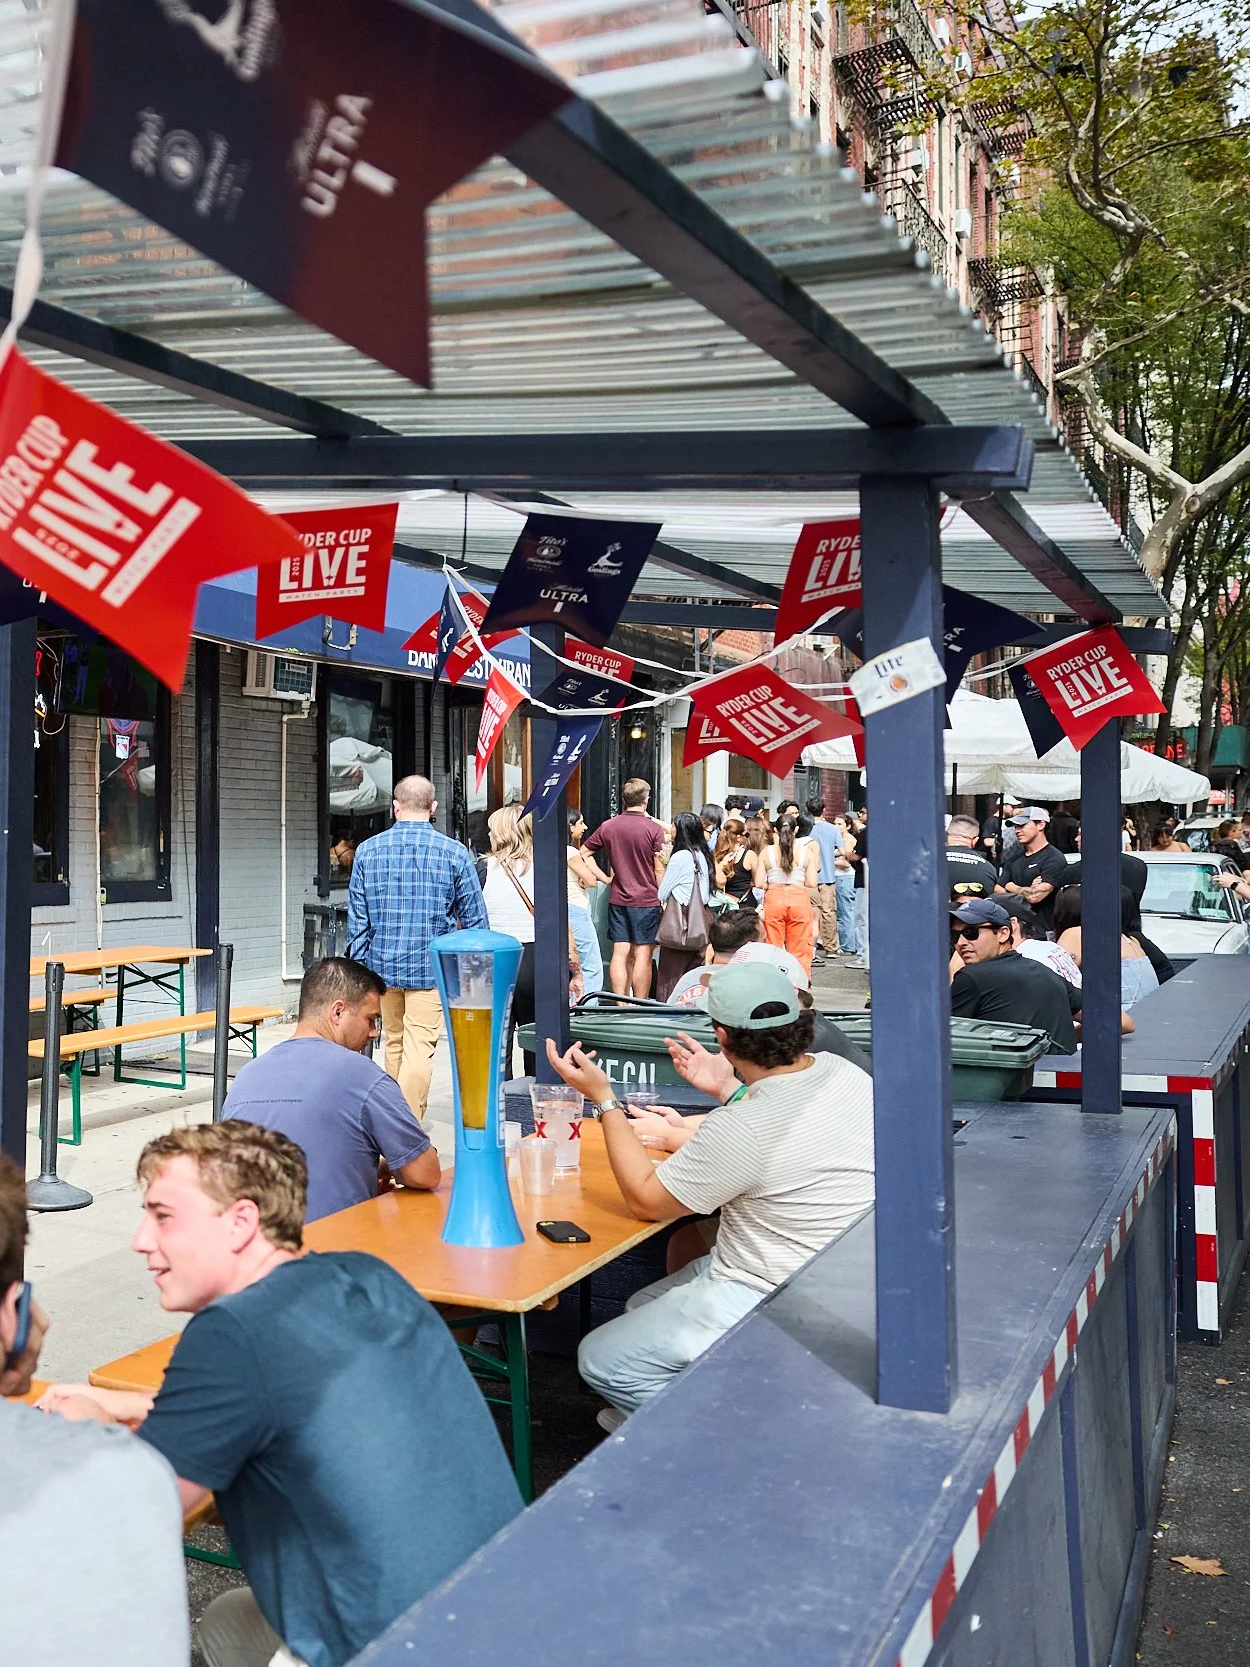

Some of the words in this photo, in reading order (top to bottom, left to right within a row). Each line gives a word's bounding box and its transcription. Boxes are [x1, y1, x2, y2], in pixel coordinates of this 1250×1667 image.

[301, 94, 374, 218] ULTRA
[15, 414, 70, 470] CUP
[10, 438, 174, 592] LIVE
[297, 531, 336, 548] DER
[339, 528, 372, 544] CUP
[816, 534, 861, 554] RYDE
[279, 545, 370, 590] LIVE
[804, 550, 861, 592] LIV
[286, 592, 320, 600] WATCH
[540, 589, 588, 603] ULTRA
[574, 651, 603, 664] RYDER
[604, 658, 622, 669] CUP
[1046, 656, 1086, 680] RYDER
[1084, 645, 1107, 662] CUP
[1054, 656, 1129, 710] LIVE
[715, 694, 756, 718] RYDER
[749, 685, 774, 703] CUP
[1078, 701, 1101, 714] WATCH
[1105, 689, 1128, 700] PARTY
[729, 696, 812, 746] LIVE
